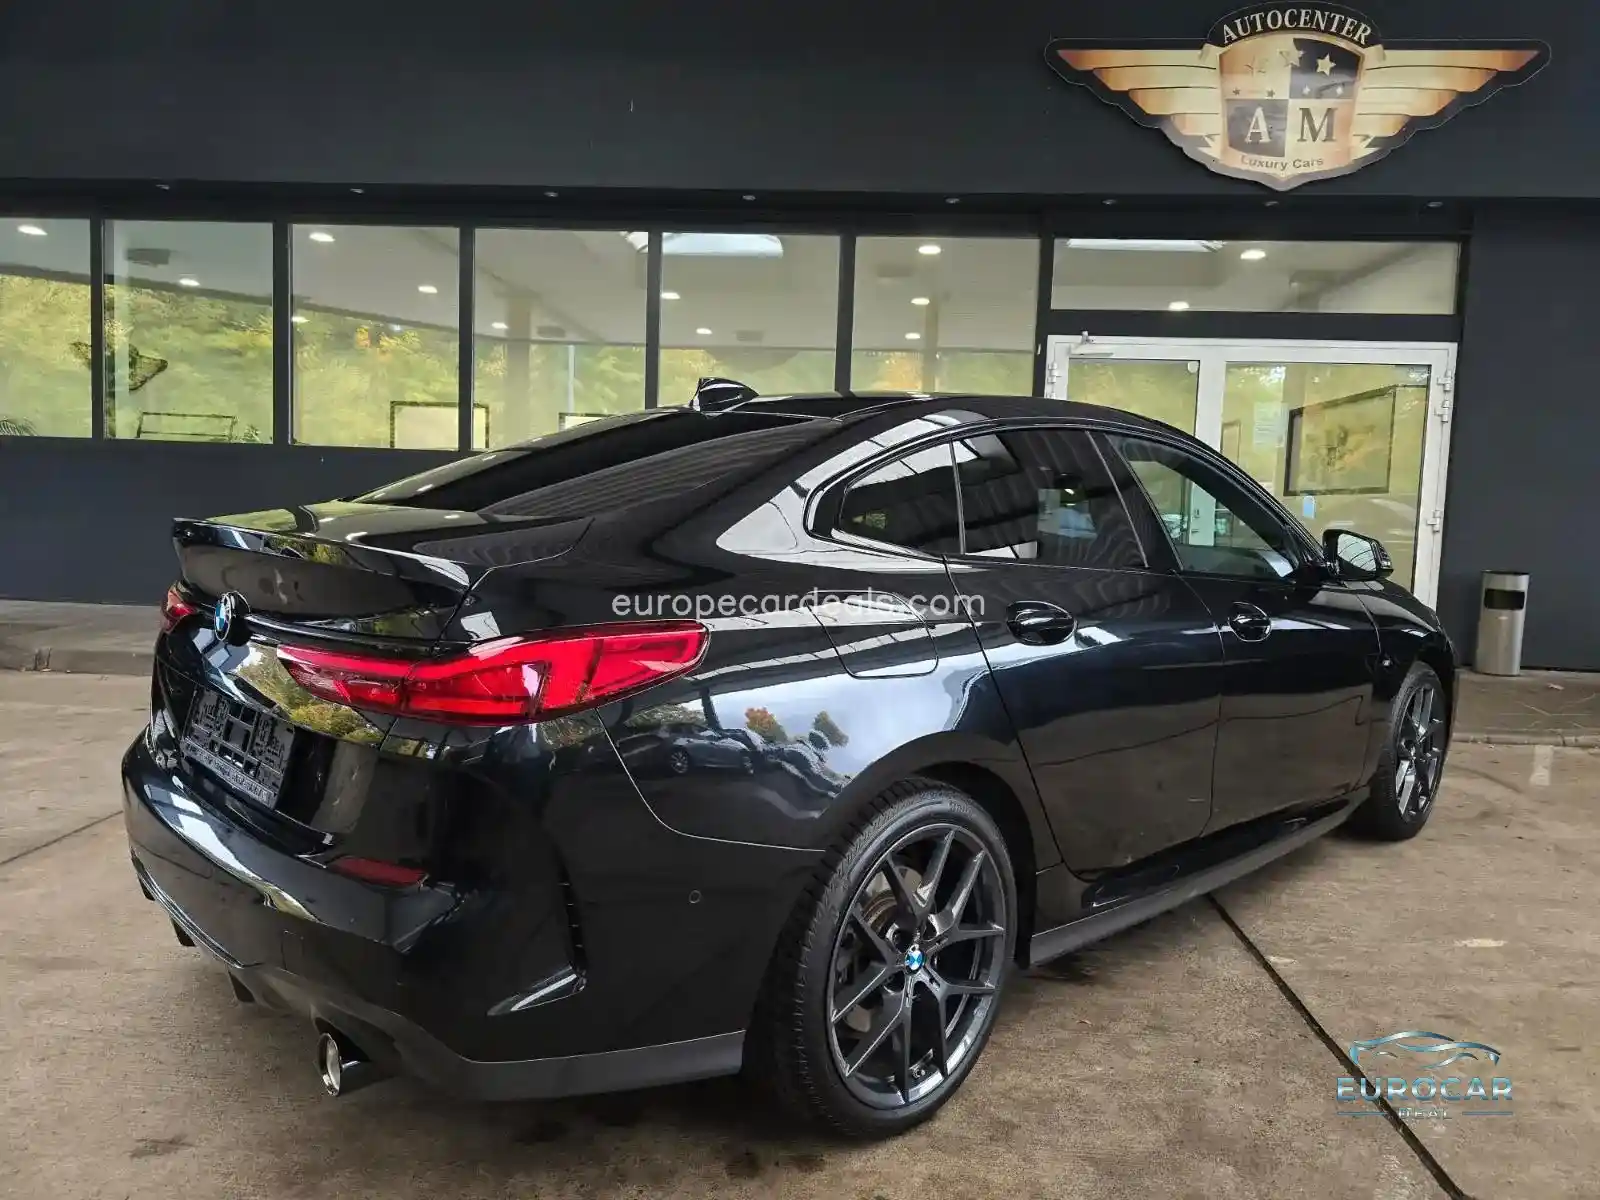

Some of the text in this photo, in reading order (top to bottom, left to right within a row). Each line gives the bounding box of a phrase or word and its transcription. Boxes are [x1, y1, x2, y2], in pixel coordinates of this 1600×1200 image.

[1223, 8, 1372, 45] AUTOCENTER
[1244, 106, 1338, 144] A M
[1240, 154, 1324, 171] Luxury Cars
